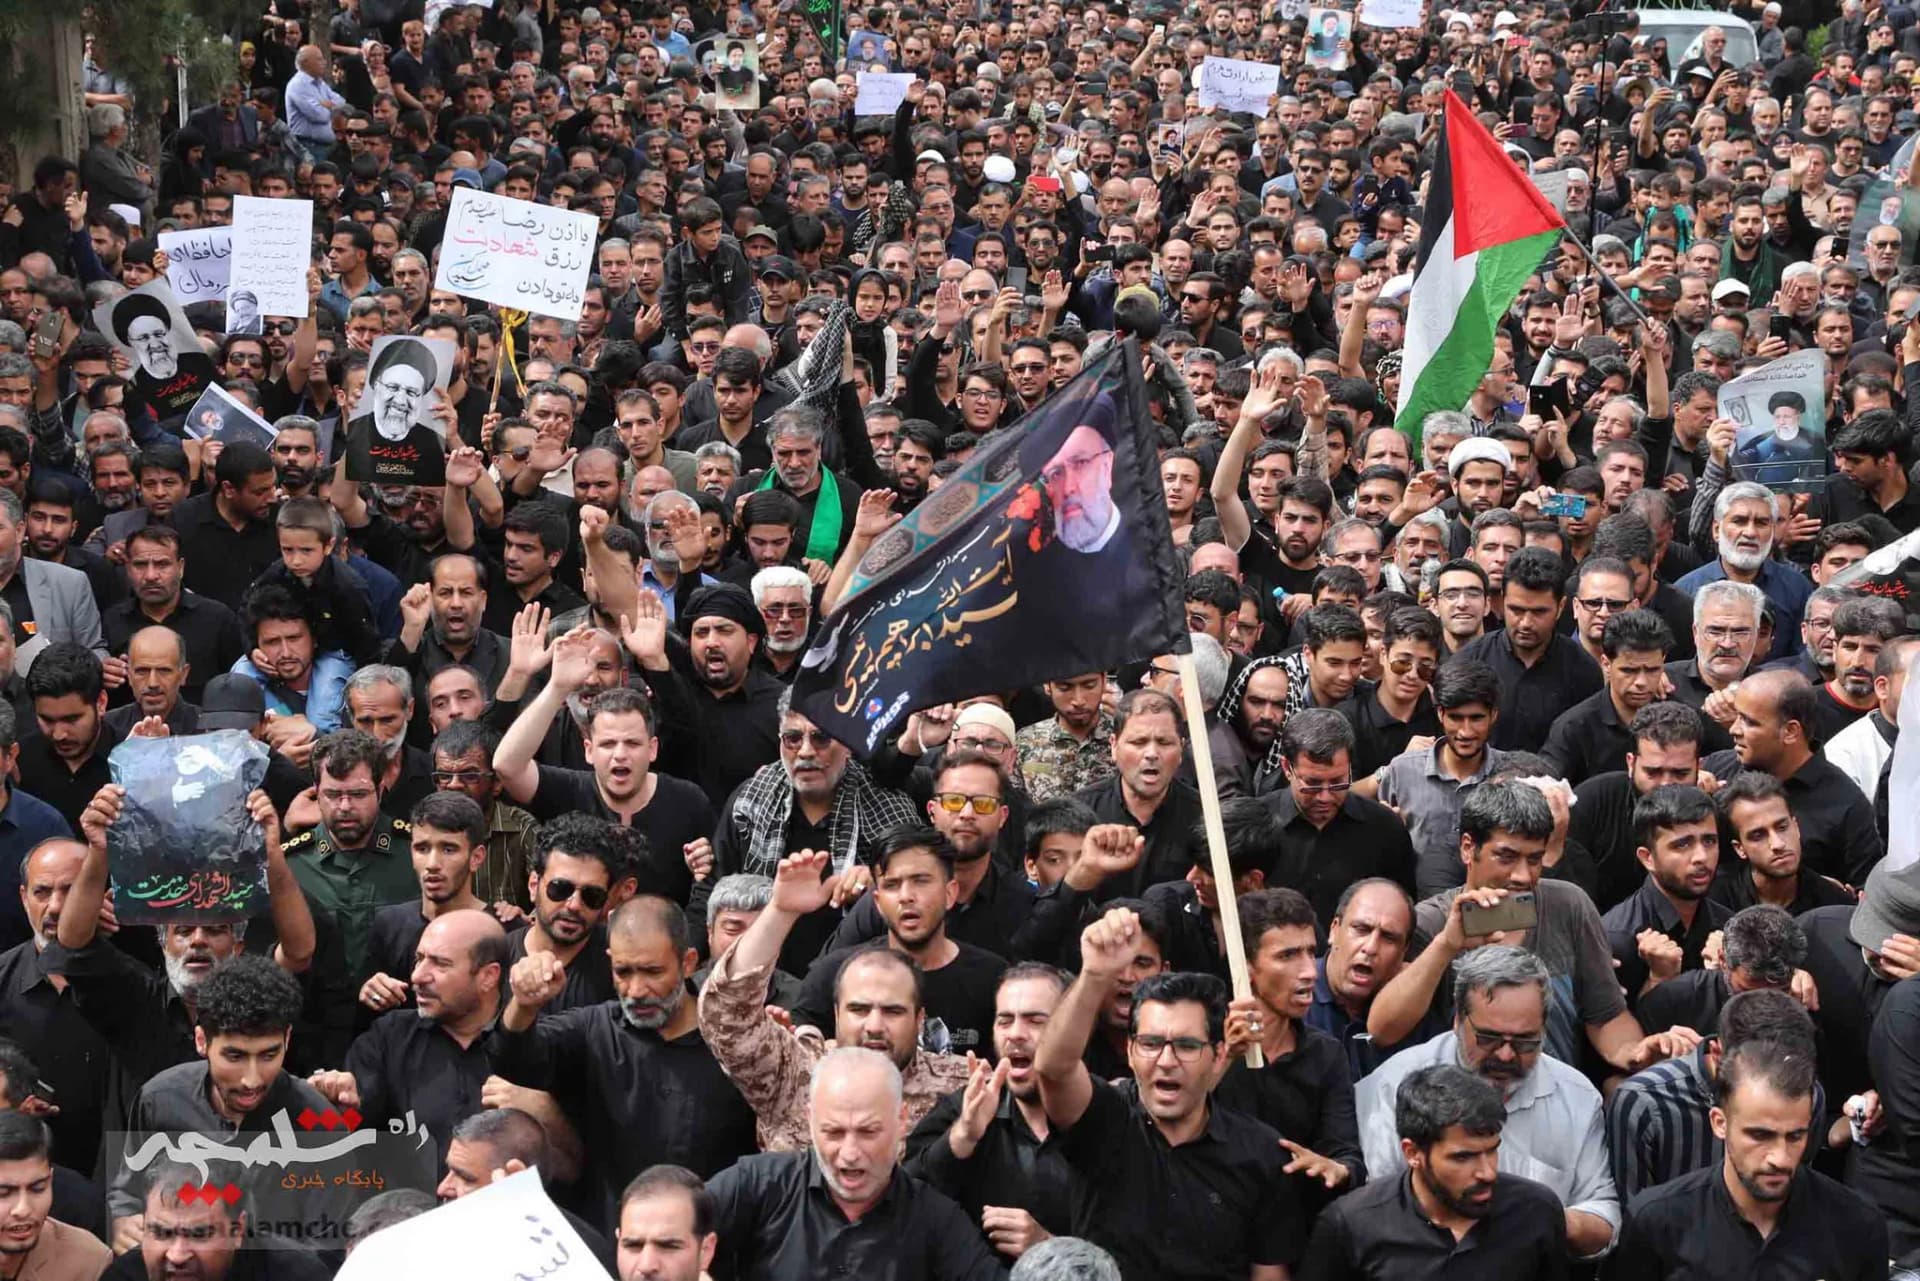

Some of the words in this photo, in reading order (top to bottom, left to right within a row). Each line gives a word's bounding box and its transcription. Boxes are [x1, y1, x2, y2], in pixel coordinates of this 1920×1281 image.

[501, 203, 546, 236] رضا
[548, 222, 578, 241] اذن
[453, 228, 540, 257] شهادت
[544, 248, 582, 271] رزق
[516, 278, 554, 298] دادن
[936, 590, 1019, 647] سید
[874, 618, 935, 676] ابراهیم
[834, 630, 876, 714] رئیسی
[127, 874, 189, 900] خدمت
